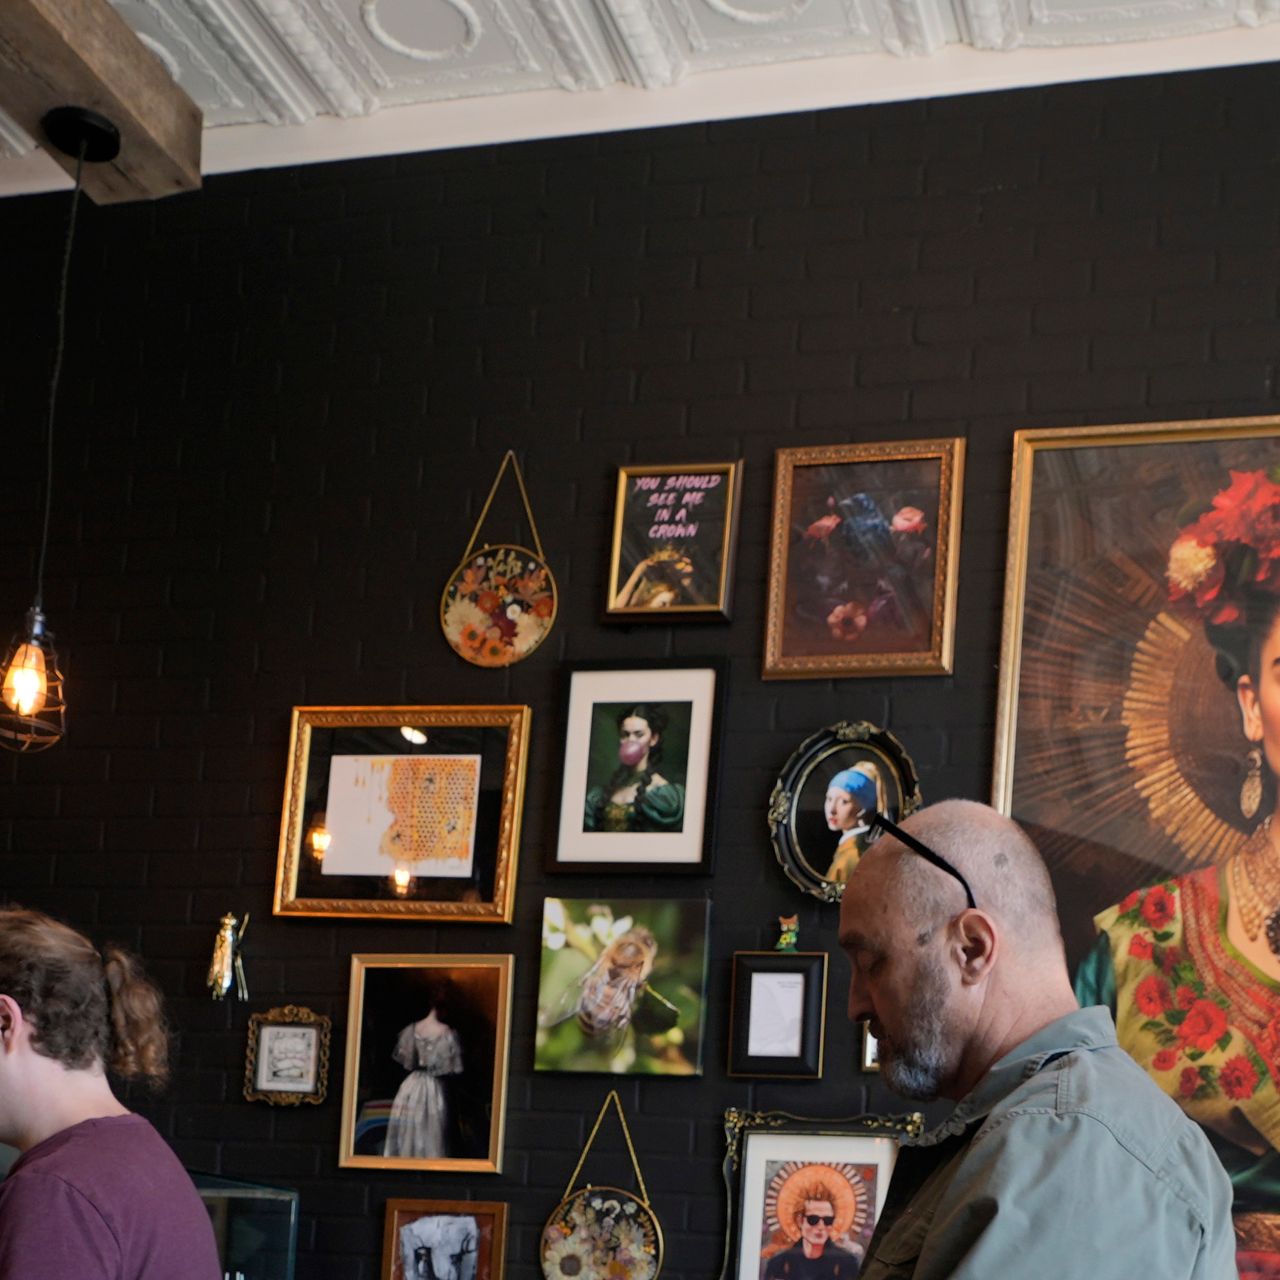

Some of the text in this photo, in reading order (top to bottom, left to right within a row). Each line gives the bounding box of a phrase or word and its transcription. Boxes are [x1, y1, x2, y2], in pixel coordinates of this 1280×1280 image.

[634, 475, 721, 491] YOU SHOULD
[647, 491, 705, 507] SEE ME
[655, 507, 687, 521] IN A
[648, 523, 699, 539] CROWN
